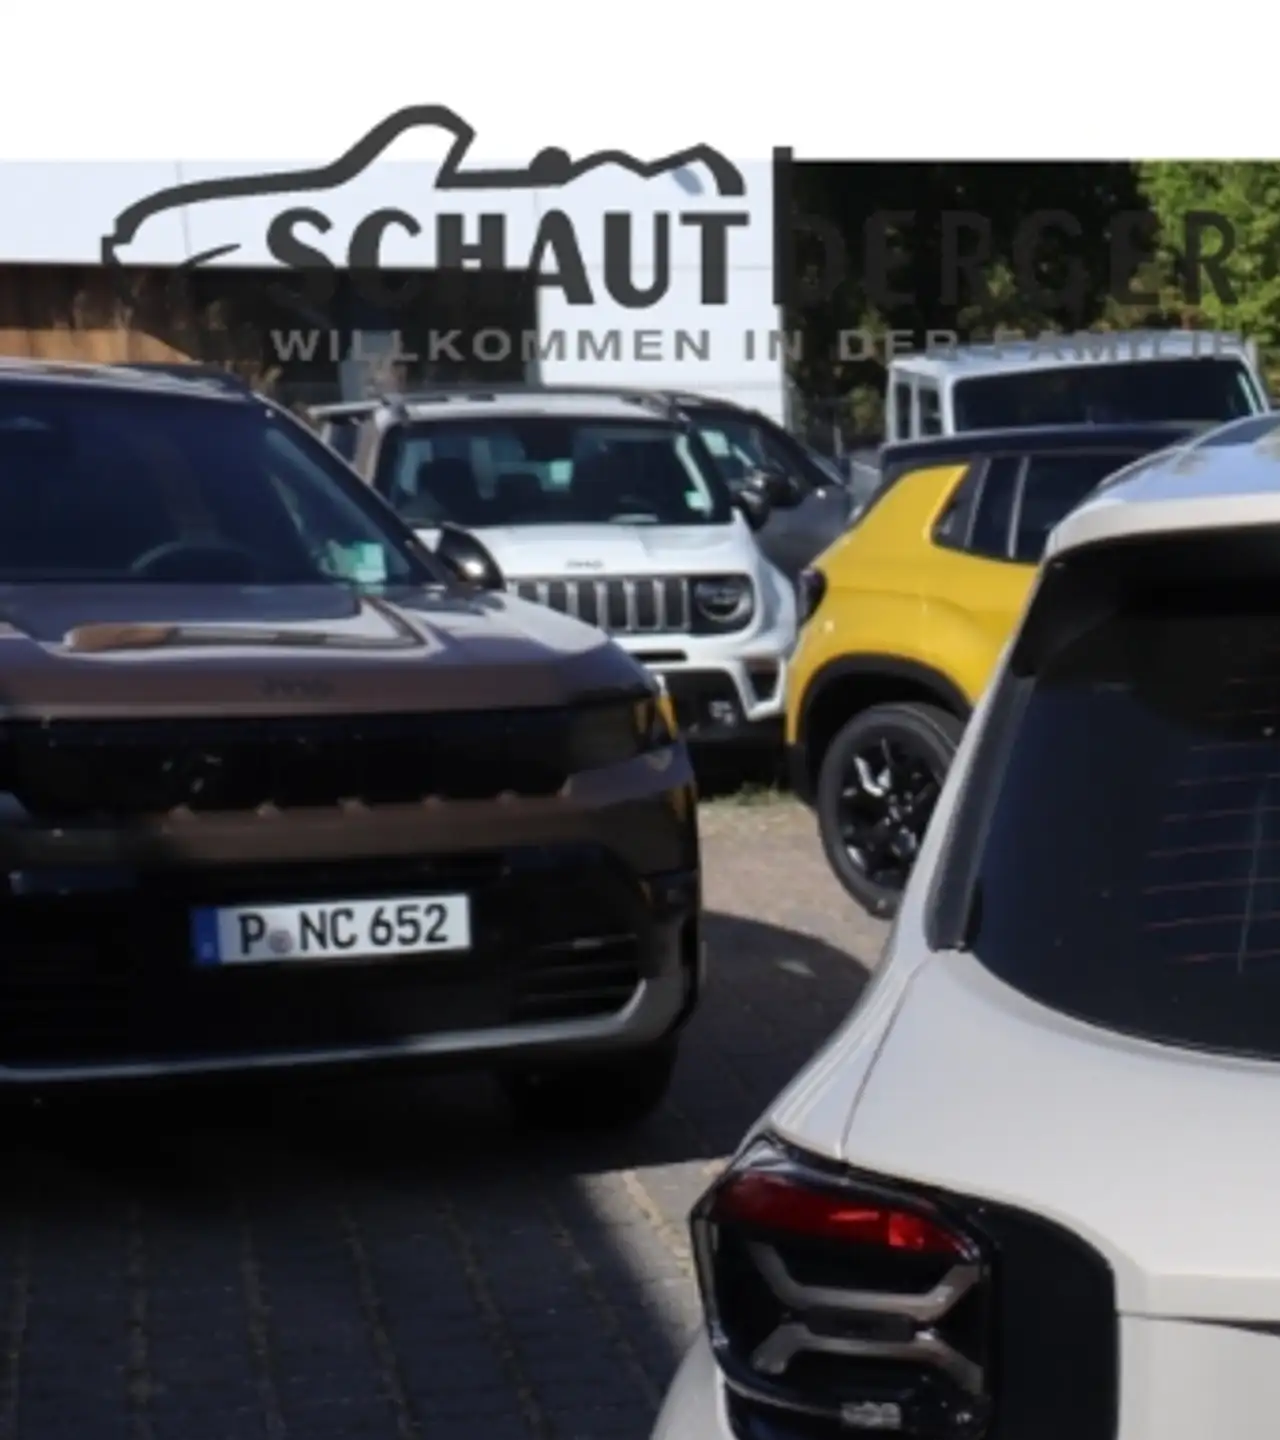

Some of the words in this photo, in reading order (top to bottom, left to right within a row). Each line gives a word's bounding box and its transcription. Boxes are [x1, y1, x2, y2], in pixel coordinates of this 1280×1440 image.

[236, 911, 266, 956] P
[299, 906, 357, 951] NC
[369, 902, 449, 947] 652
